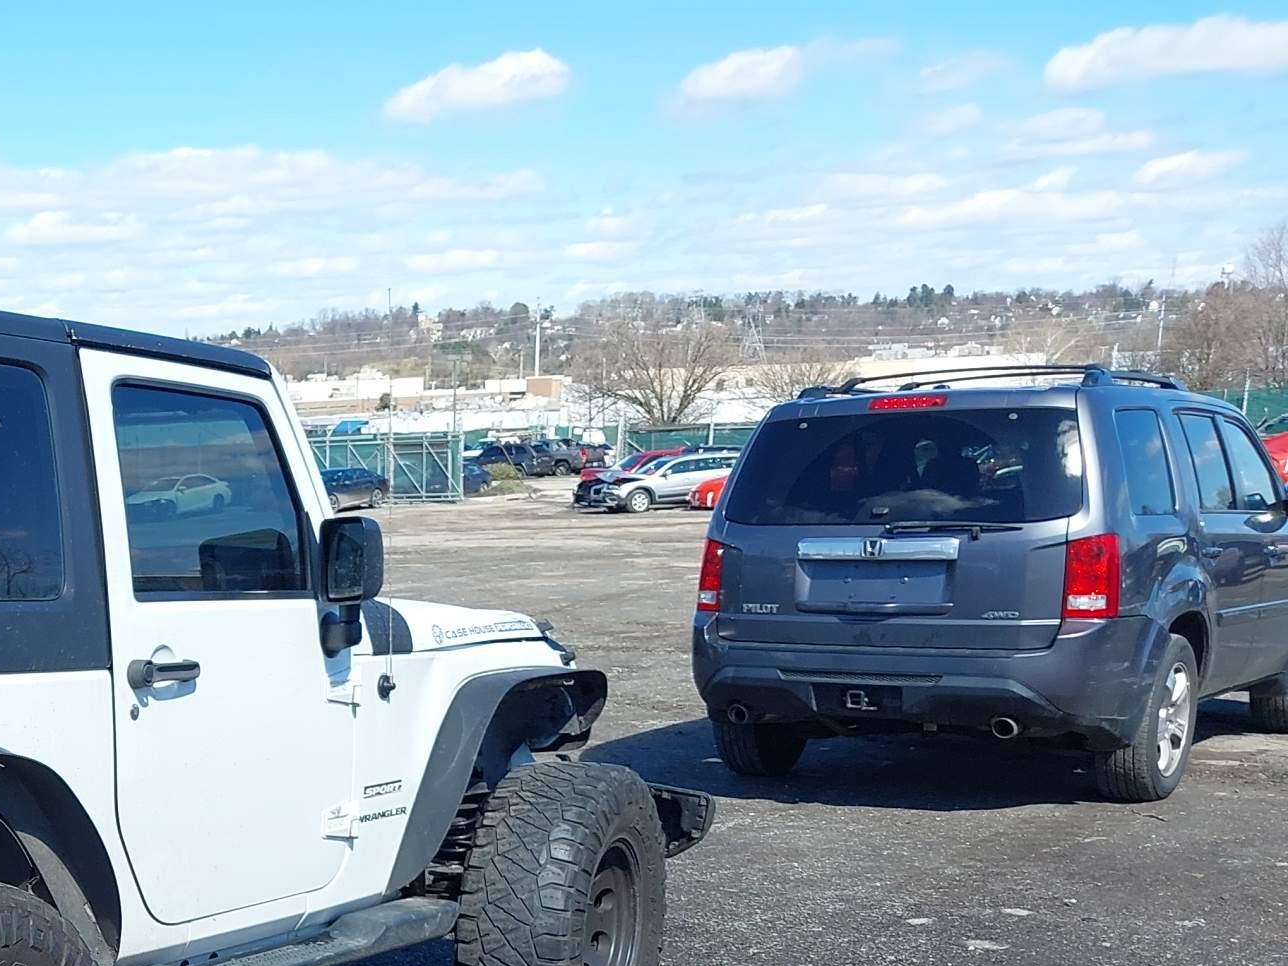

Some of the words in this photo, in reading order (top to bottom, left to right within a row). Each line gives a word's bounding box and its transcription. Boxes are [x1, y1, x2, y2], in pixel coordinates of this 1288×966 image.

[742, 603, 780, 614] PILOT
[980, 610, 1021, 620] 4WD
[445, 627, 469, 640] CASE
[469, 624, 496, 636] HOUSE
[363, 781, 403, 798] SPORT
[359, 806, 408, 823] WRANGLER
